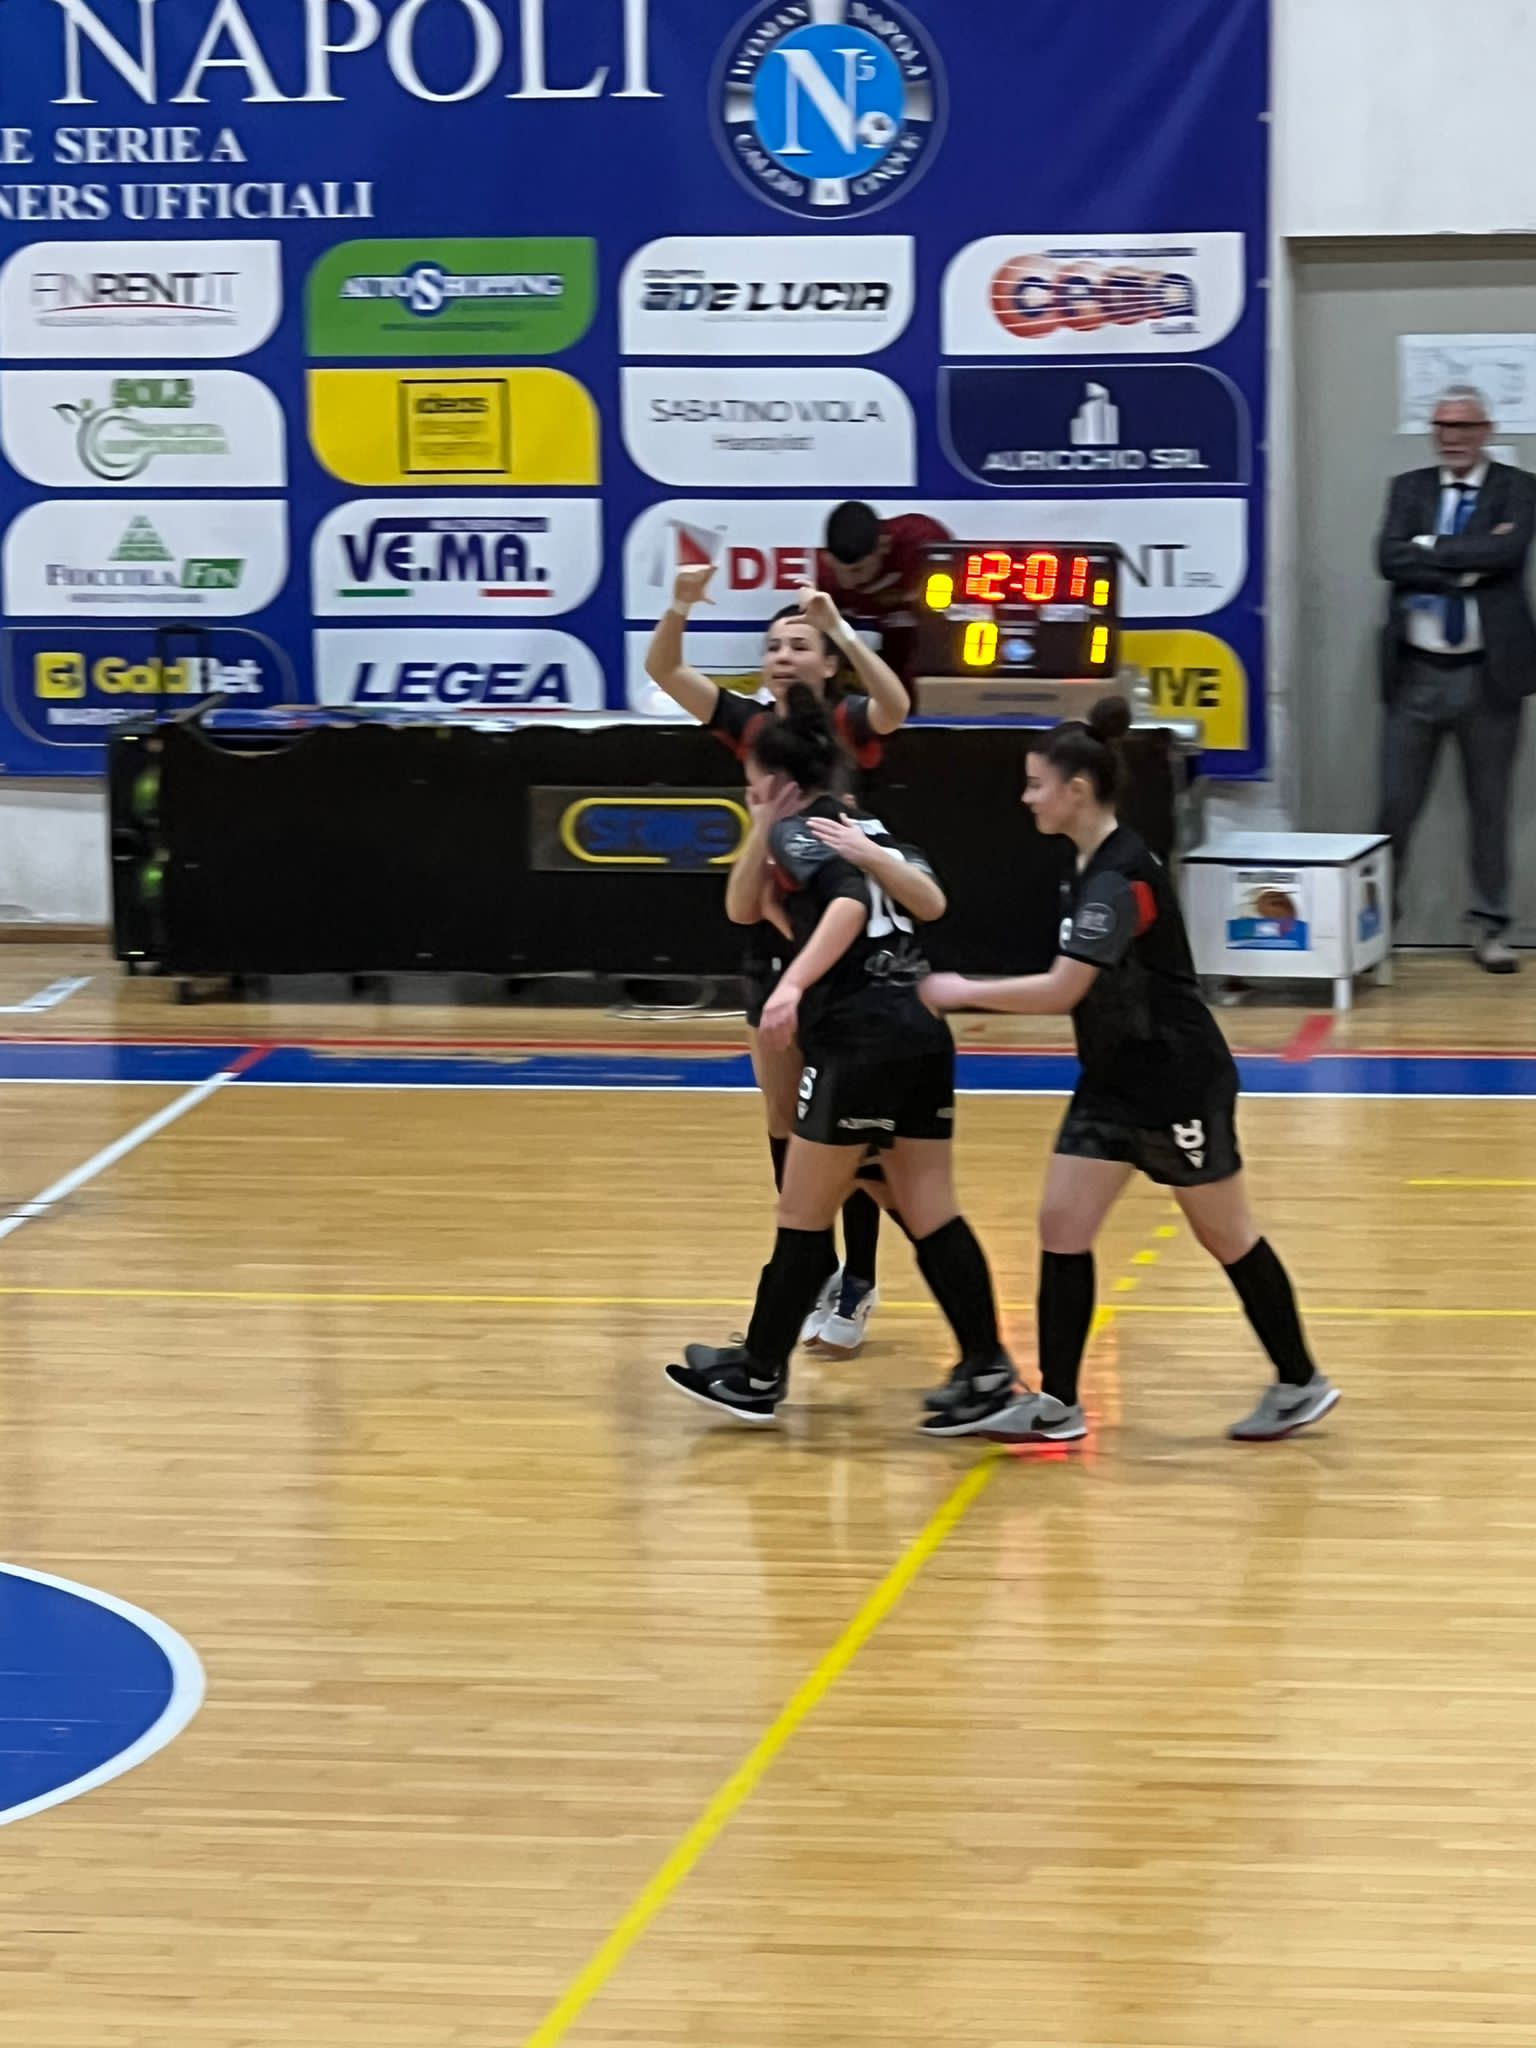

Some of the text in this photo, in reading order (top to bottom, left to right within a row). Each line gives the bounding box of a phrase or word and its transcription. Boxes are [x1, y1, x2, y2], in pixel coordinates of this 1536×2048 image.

[49, 0, 664, 103] NAPOLI
[0, 127, 248, 164] E SERIE A
[120, 181, 375, 220] UFFICIALI
[965, 551, 1089, 601] 12:01
[963, 622, 1108, 666] 0 1
[352, 662, 573, 704] LEGEA
[1149, 667, 1220, 707] IVE
